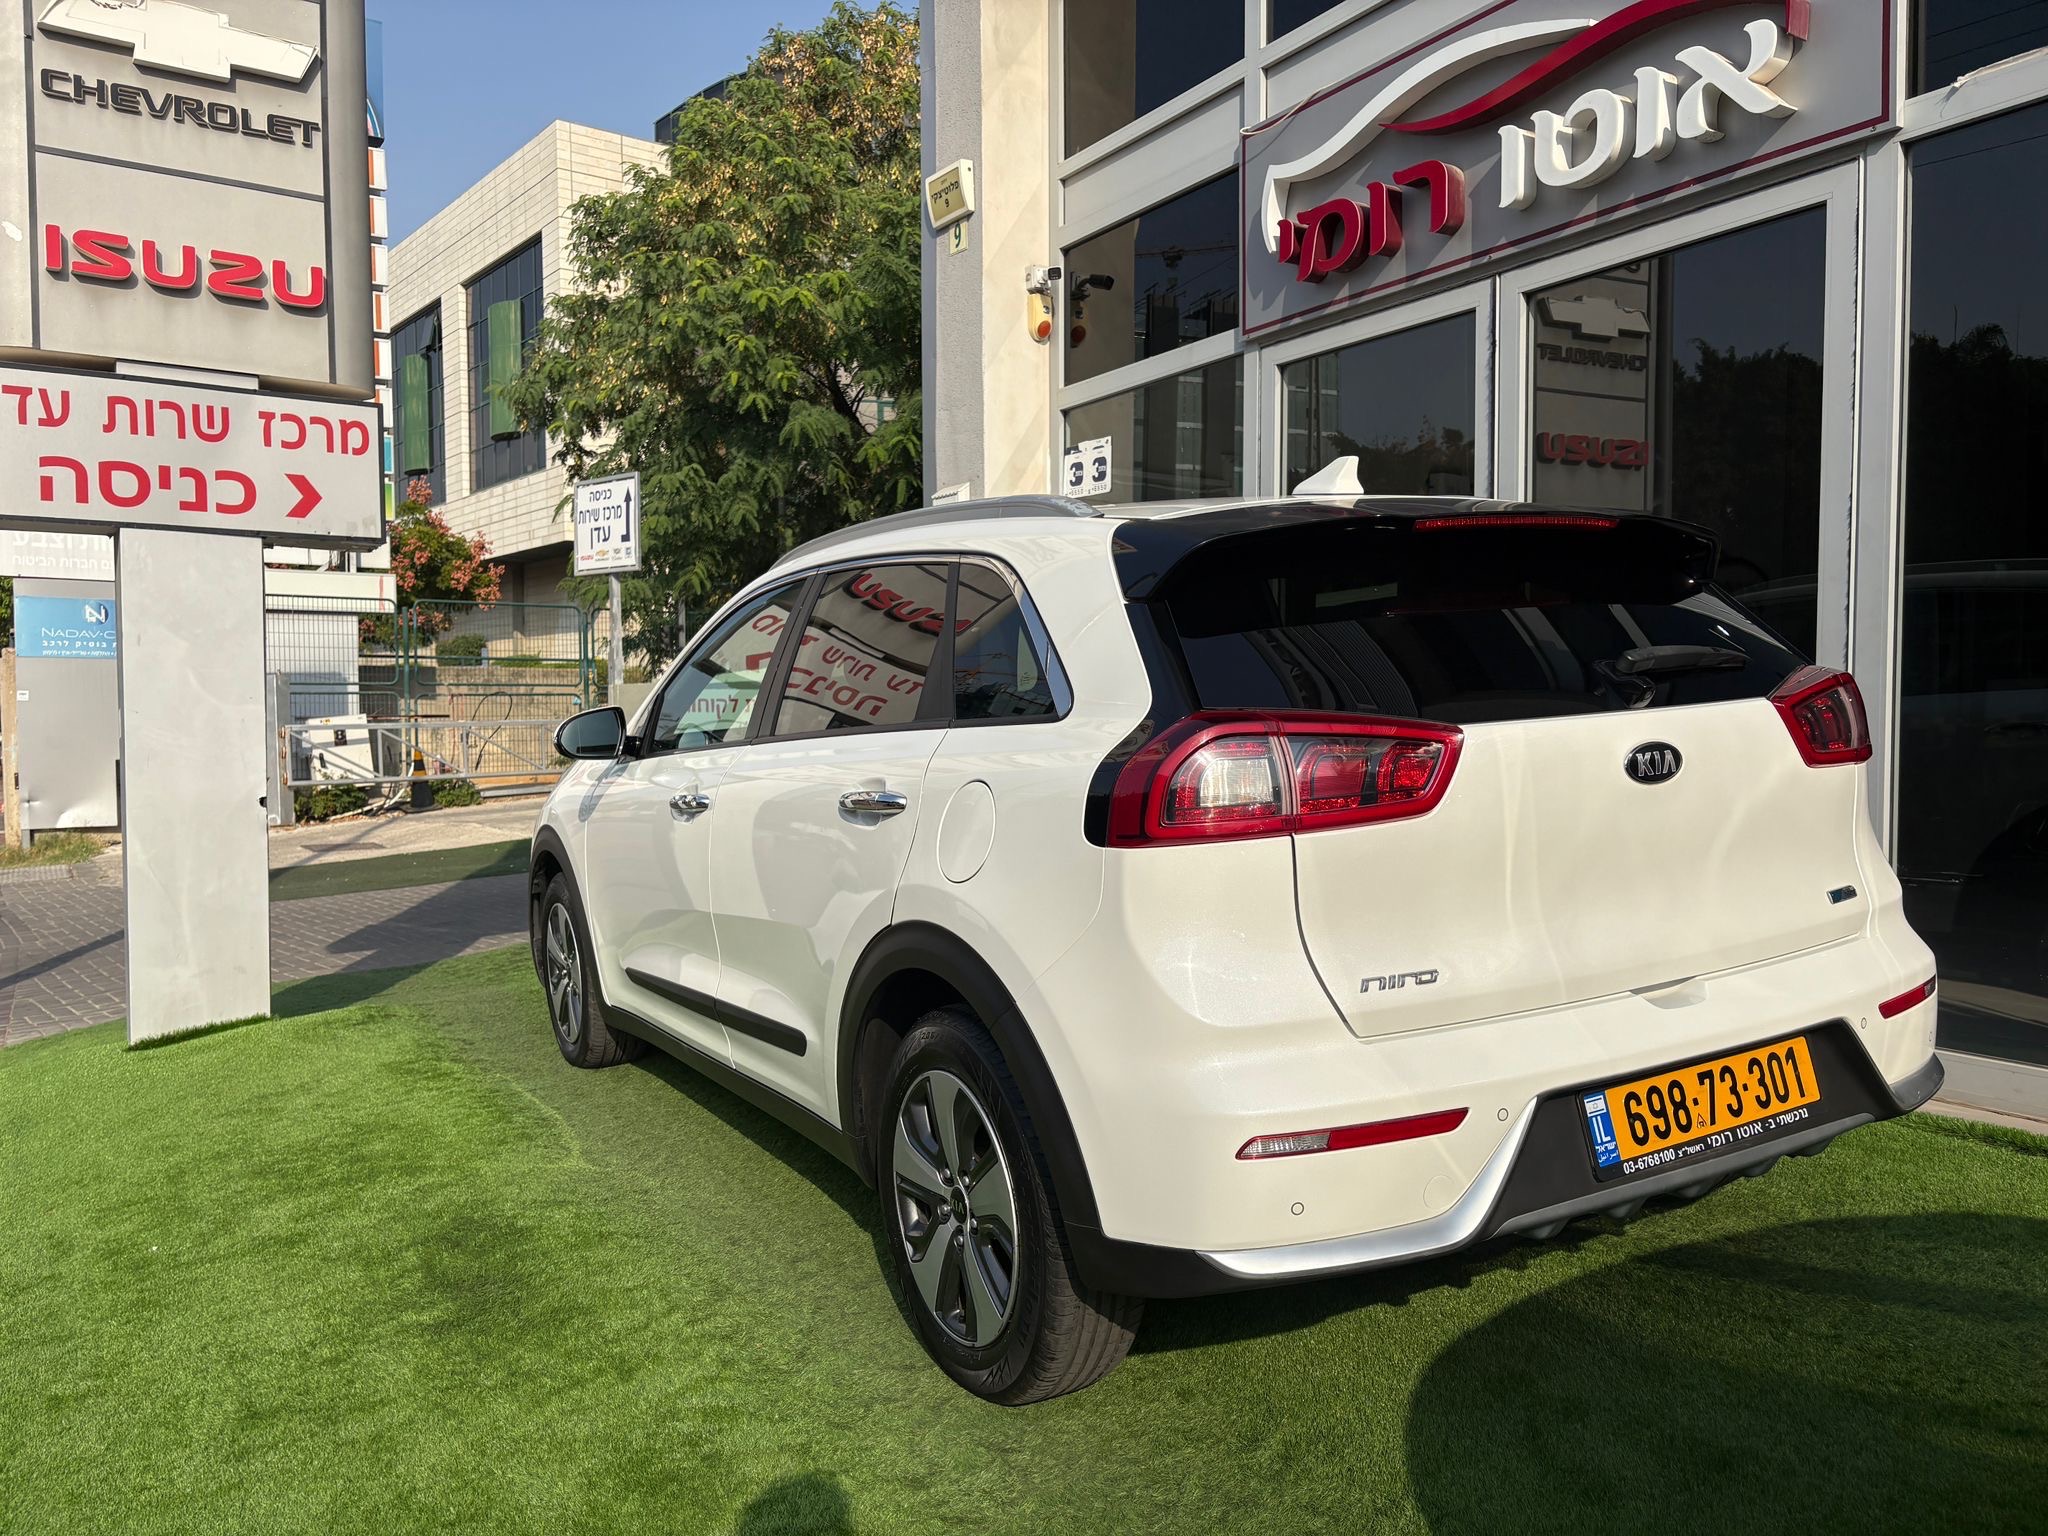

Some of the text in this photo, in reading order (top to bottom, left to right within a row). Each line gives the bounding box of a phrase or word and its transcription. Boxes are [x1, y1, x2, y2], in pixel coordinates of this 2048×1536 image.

[40, 68, 321, 147] CHEVROLET
[1277, 19, 1798, 283] אוטו רומי
[954, 223, 961, 248] 9
[45, 224, 325, 308] ISUZU
[102, 395, 230, 443] שרות
[258, 410, 370, 456] מרכז
[39, 456, 257, 514] כניסה
[589, 488, 612, 502] כניסה
[578, 505, 622, 524] מרכז שירות
[590, 526, 611, 550] עדן
[1636, 750, 1676, 776] KIA
[1592, 1115, 1611, 1143] IL
[1777, 1107, 1809, 1126] נרכשתי
[1707, 1131, 1733, 1148] רומי
[1736, 1121, 1764, 1140] אוטו
[1623, 1148, 1676, 1175] 03-6768100
